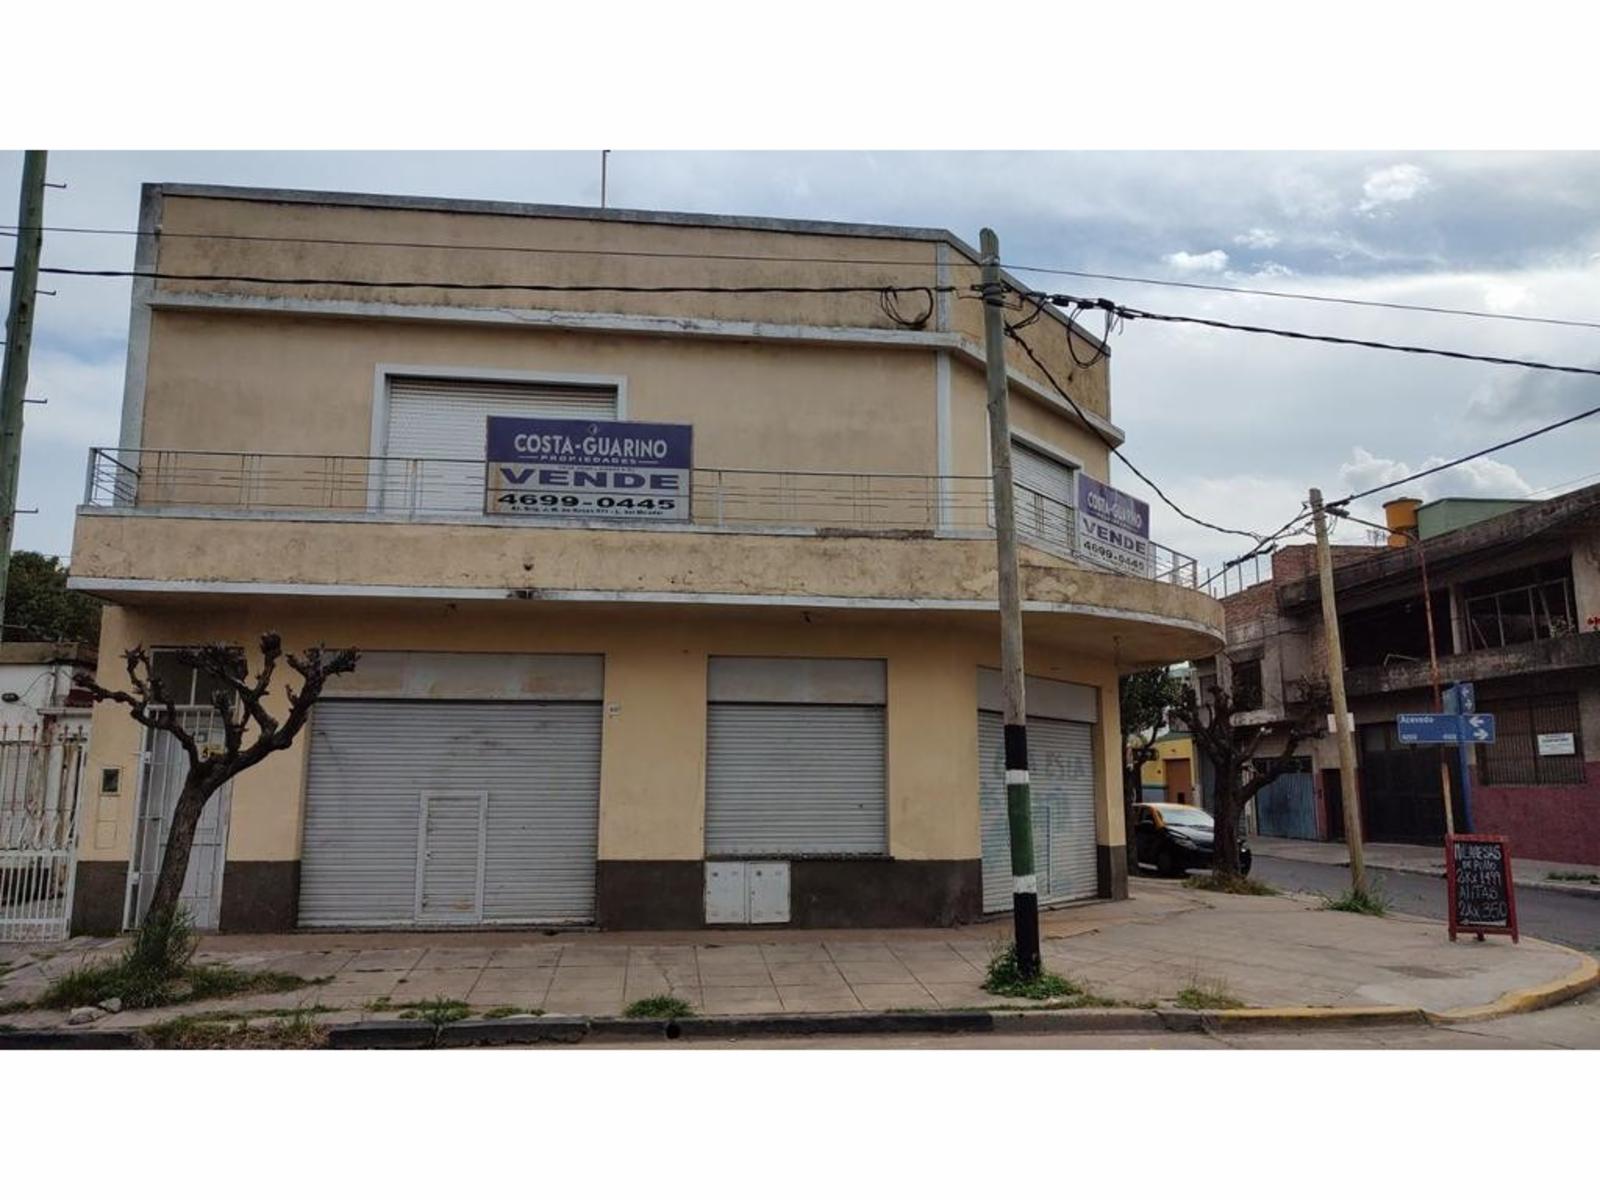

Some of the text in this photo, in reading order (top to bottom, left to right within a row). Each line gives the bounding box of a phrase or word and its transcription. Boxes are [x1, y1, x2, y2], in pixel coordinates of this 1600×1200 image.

[514, 434, 668, 458] COSTA-GUARINO
[539, 455, 636, 465] PROPIEDADES
[500, 468, 679, 489] VENDE
[497, 493, 676, 510] 4699-0445
[1083, 518, 1146, 555] VENDE
[1399, 715, 1434, 724] Acevedo
